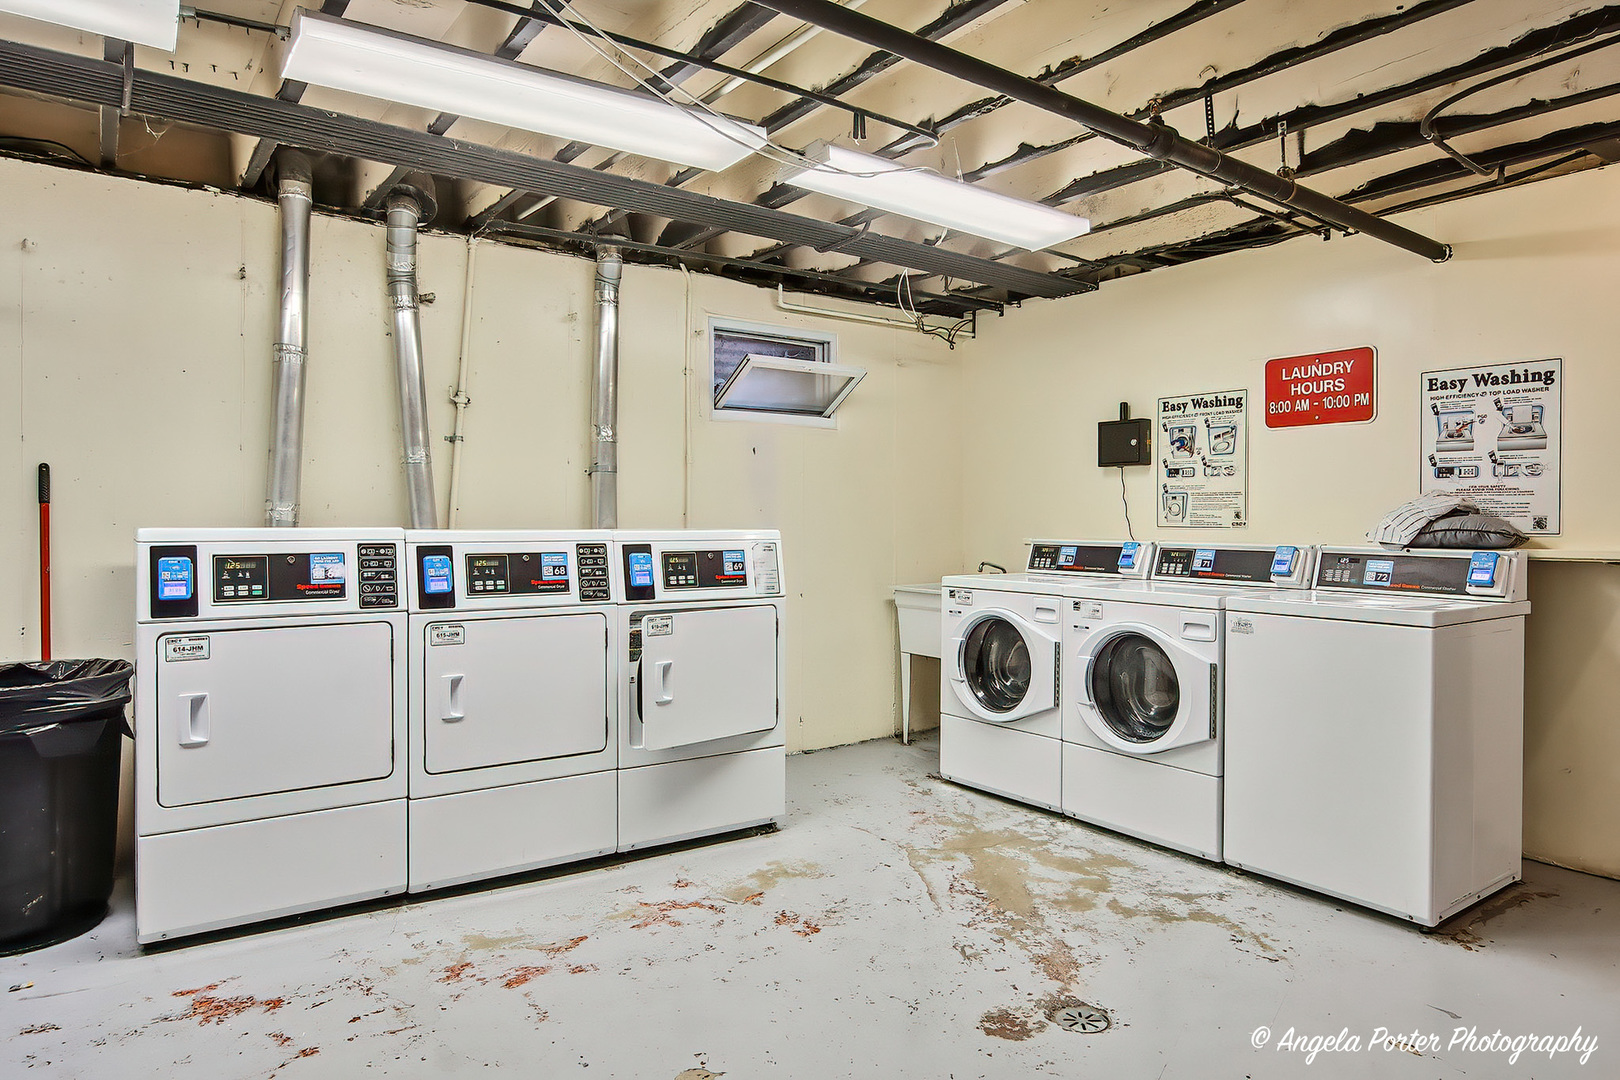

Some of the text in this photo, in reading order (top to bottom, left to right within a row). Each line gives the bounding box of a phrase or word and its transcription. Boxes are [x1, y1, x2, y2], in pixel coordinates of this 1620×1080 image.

[1281, 360, 1355, 381] LAUNDRY
[1290, 378, 1346, 396] HOURS
[1427, 369, 1556, 393] Easy Washing
[1445, 392, 1479, 400] EFFICIENCY
[1162, 395, 1244, 414] Easy Washing
[1269, 400, 1291, 414] 8:00
[1294, 398, 1310, 412] AM
[1322, 394, 1350, 409] 10:00
[1354, 392, 1369, 406] PM
[554, 566, 566, 575] 68
[733, 563, 743, 571] 69
[1376, 573, 1388, 581] 72
[173, 645, 204, 653] 614-JHM
